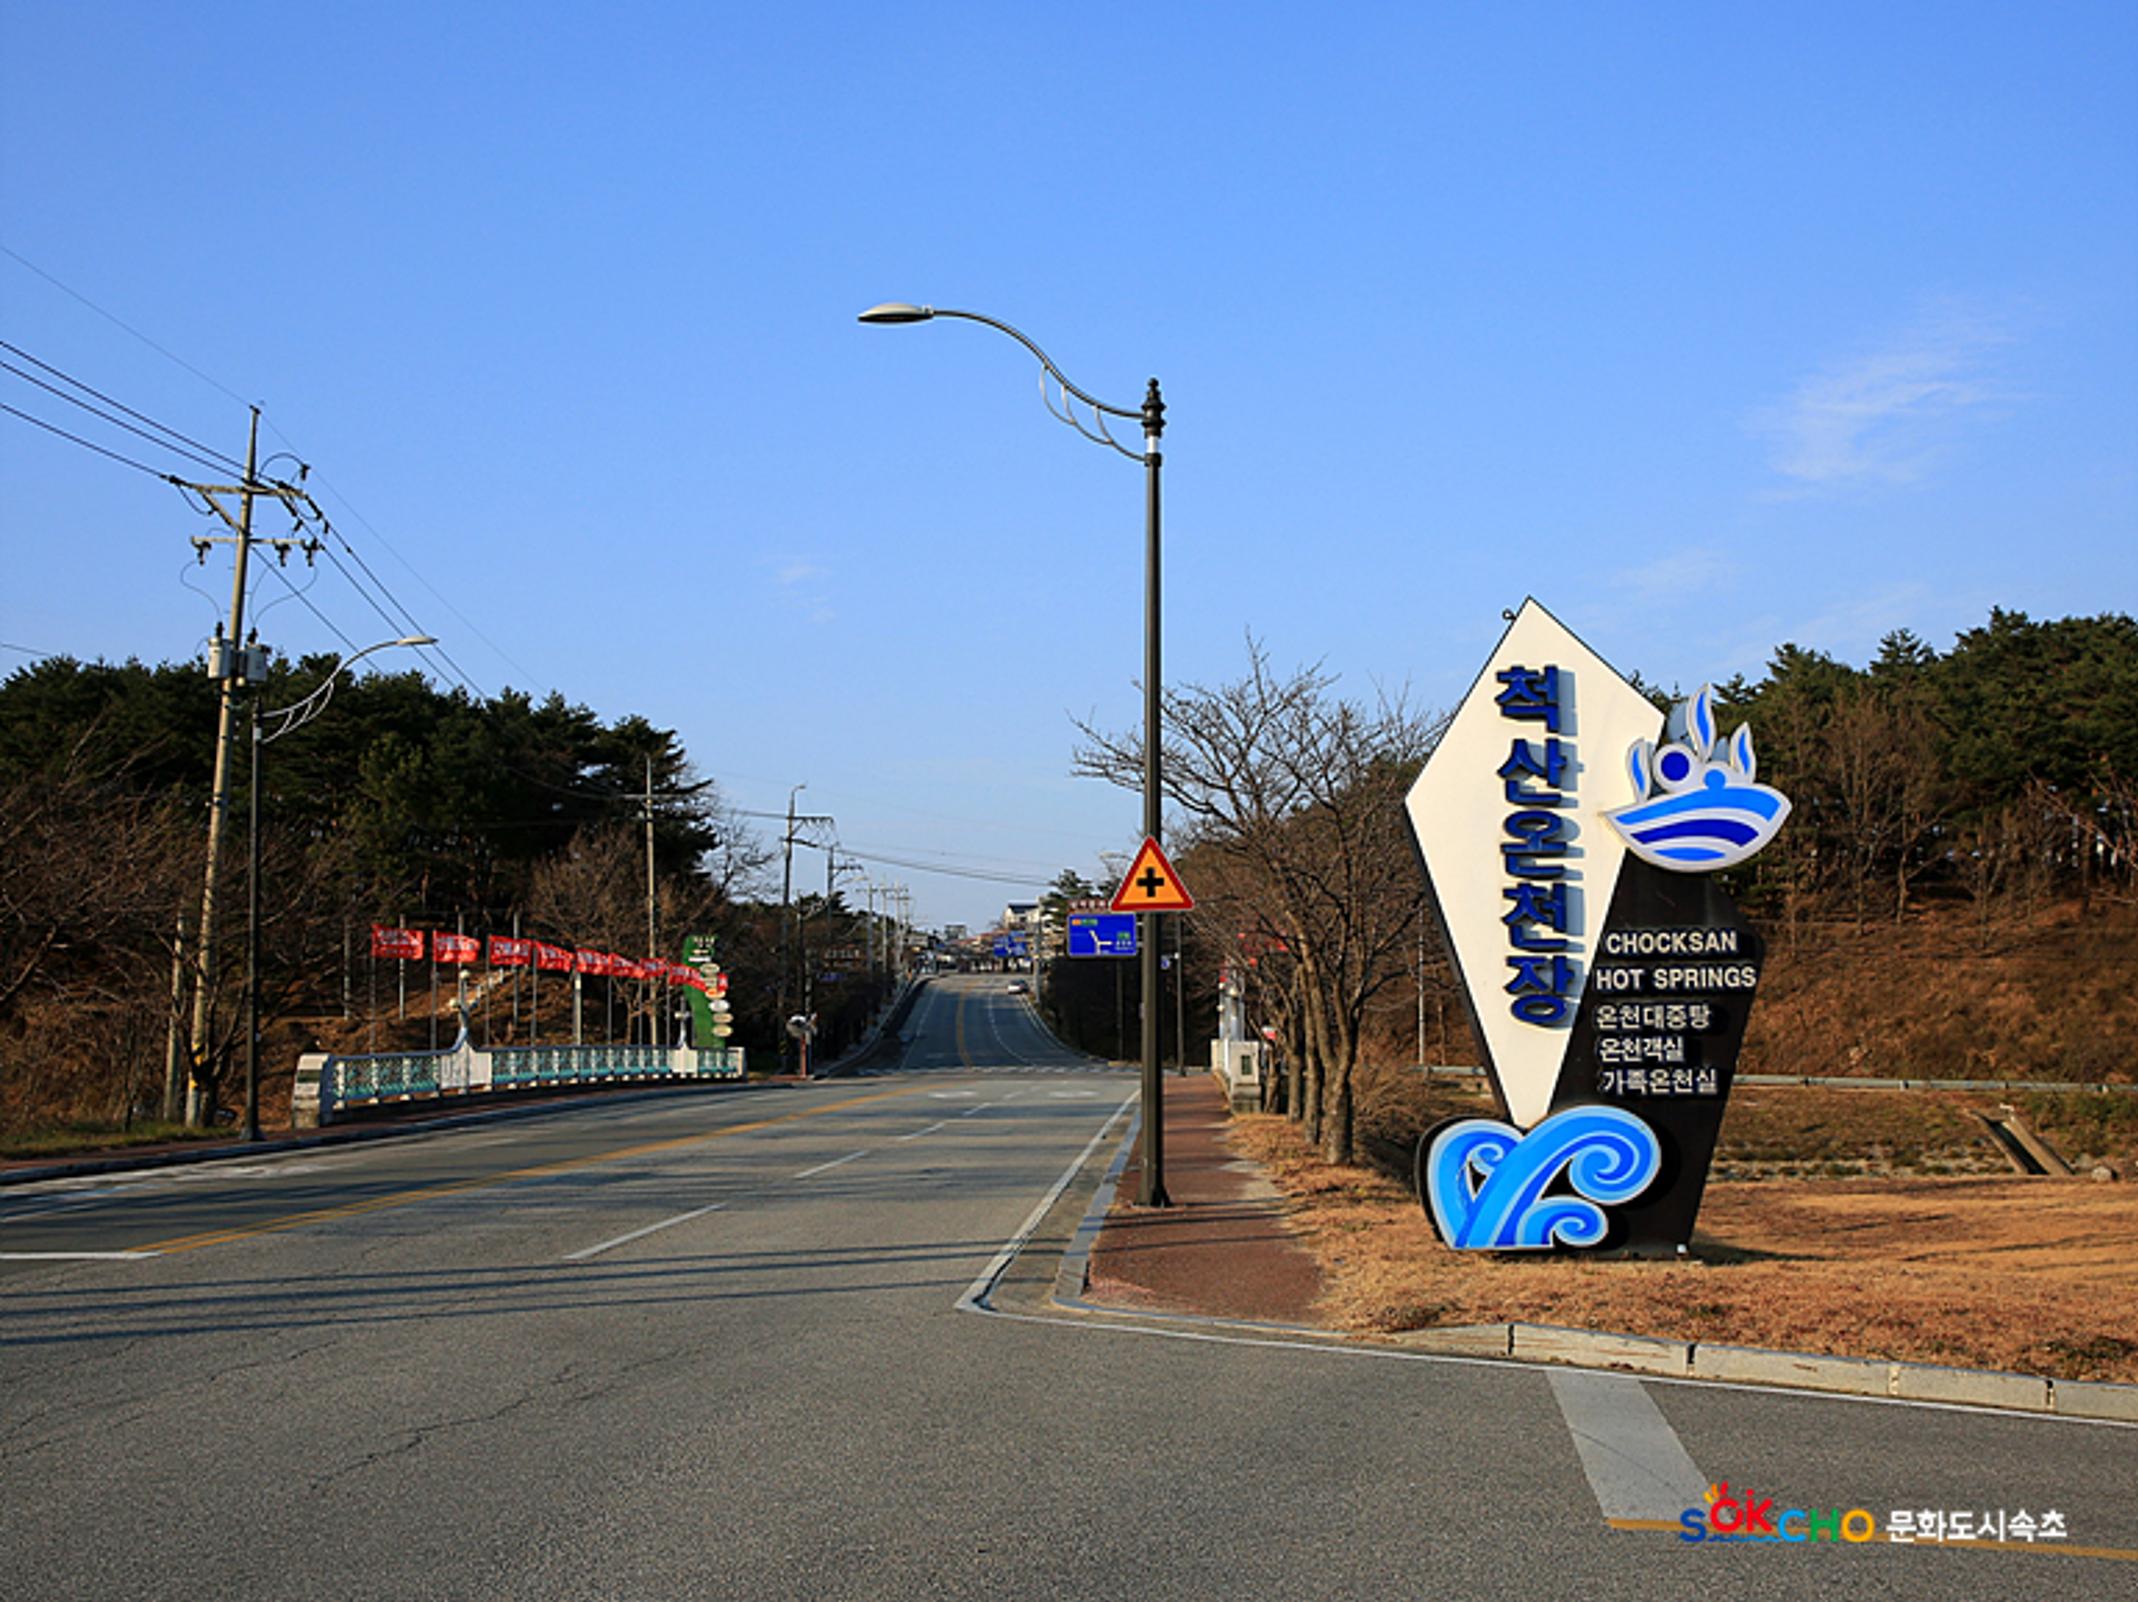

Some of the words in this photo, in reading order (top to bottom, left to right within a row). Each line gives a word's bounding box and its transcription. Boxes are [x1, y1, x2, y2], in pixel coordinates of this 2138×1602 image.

[1495, 664, 1576, 1026] 척산온천장
[1606, 931, 1737, 953] CHOCKSAN
[1596, 968, 1645, 989] HOT
[1653, 966, 1757, 988] SPRINGS
[1597, 1004, 1712, 1029] 온천대중탕
[1600, 1036, 1684, 1062] 온천객실
[1602, 1068, 1718, 1095] 가족온천실
